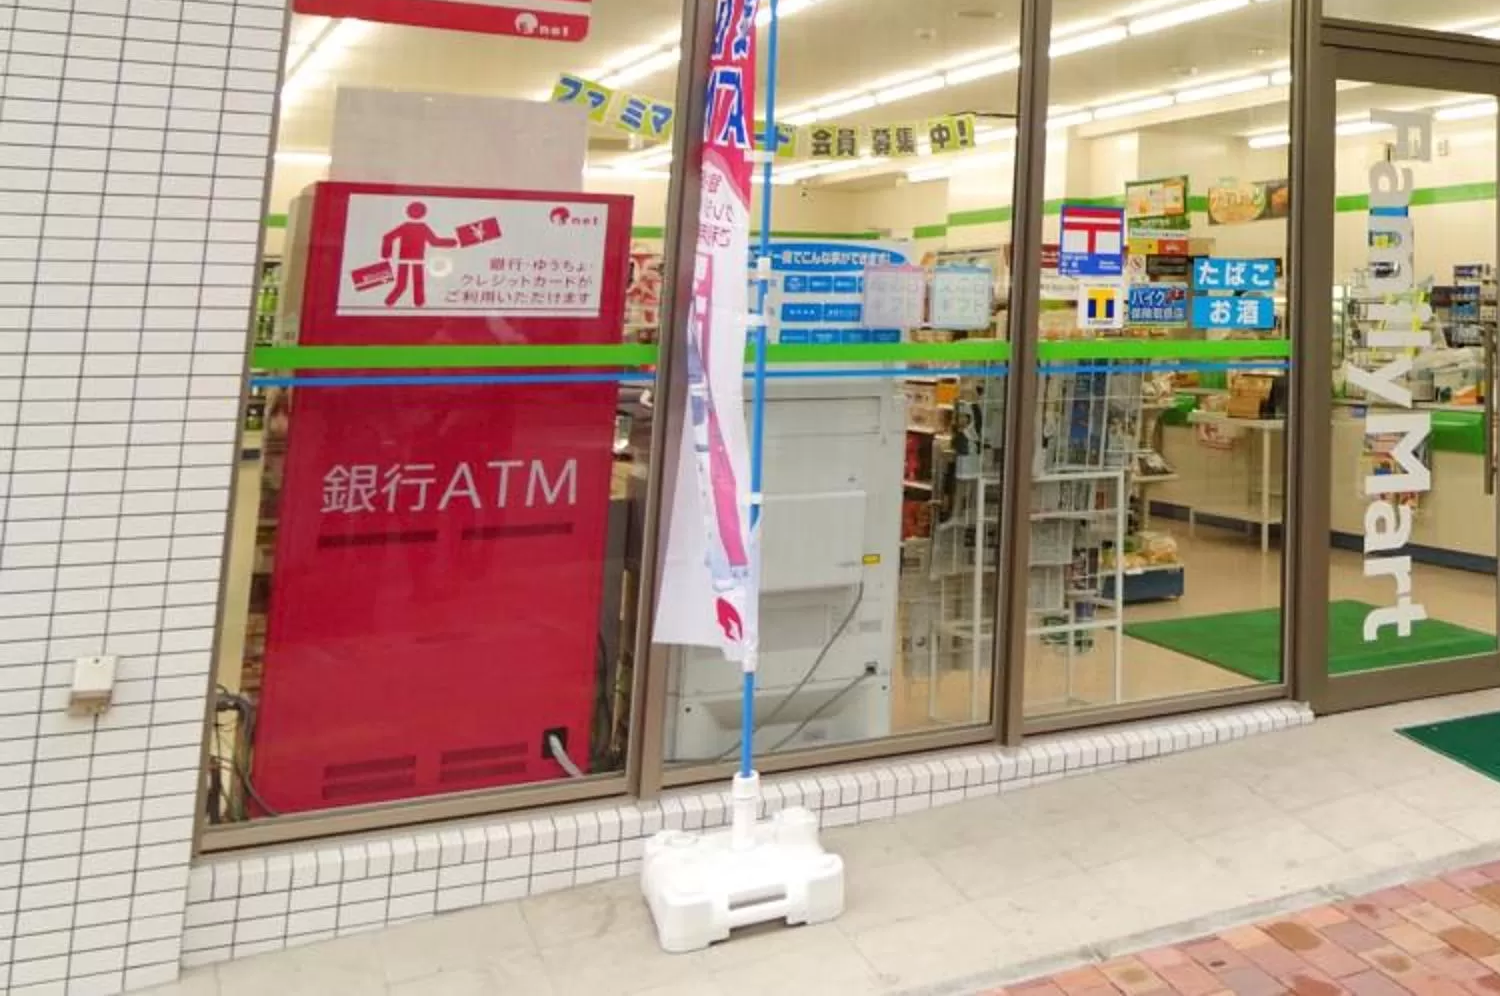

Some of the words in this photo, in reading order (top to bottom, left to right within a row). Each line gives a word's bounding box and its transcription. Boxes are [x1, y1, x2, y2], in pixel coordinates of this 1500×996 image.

[461, 273, 593, 288] クレジットカードが
[1199, 261, 1271, 286] たばこ
[444, 288, 592, 304] ご利用いただけます
[1210, 298, 1260, 324] お酒
[1344, 108, 1432, 641] FamilyMart
[320, 459, 578, 514] 銀行ATM
